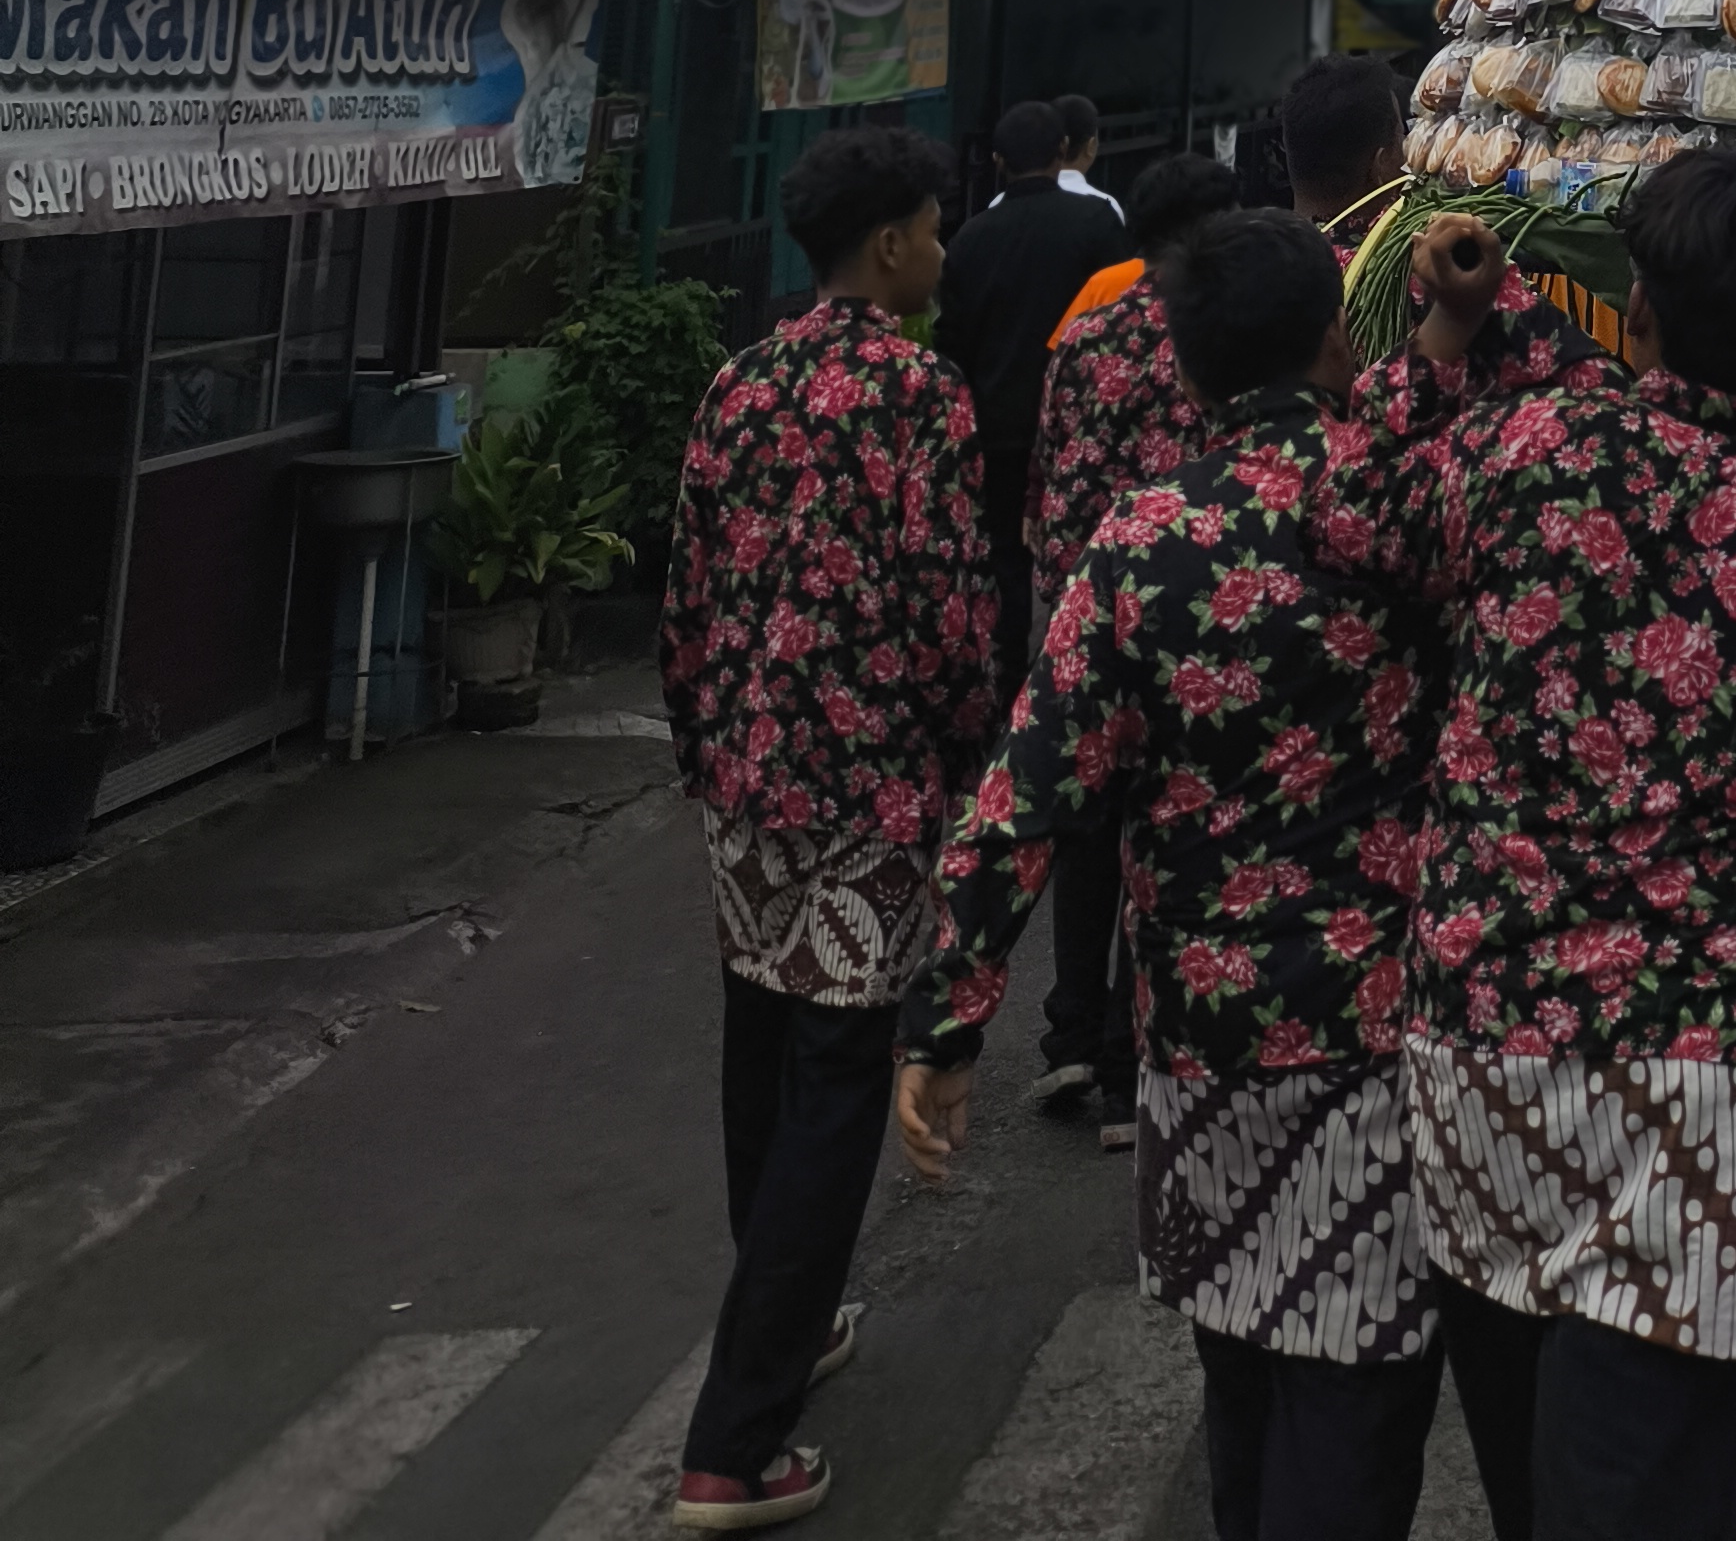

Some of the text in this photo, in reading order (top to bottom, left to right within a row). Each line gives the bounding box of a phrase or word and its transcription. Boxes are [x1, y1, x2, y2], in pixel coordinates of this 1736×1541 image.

[116, 100, 146, 128] NO.
[6, 158, 88, 218] SAPI
[108, 147, 269, 210] BRONGKOS
[286, 143, 374, 196] LODEH
